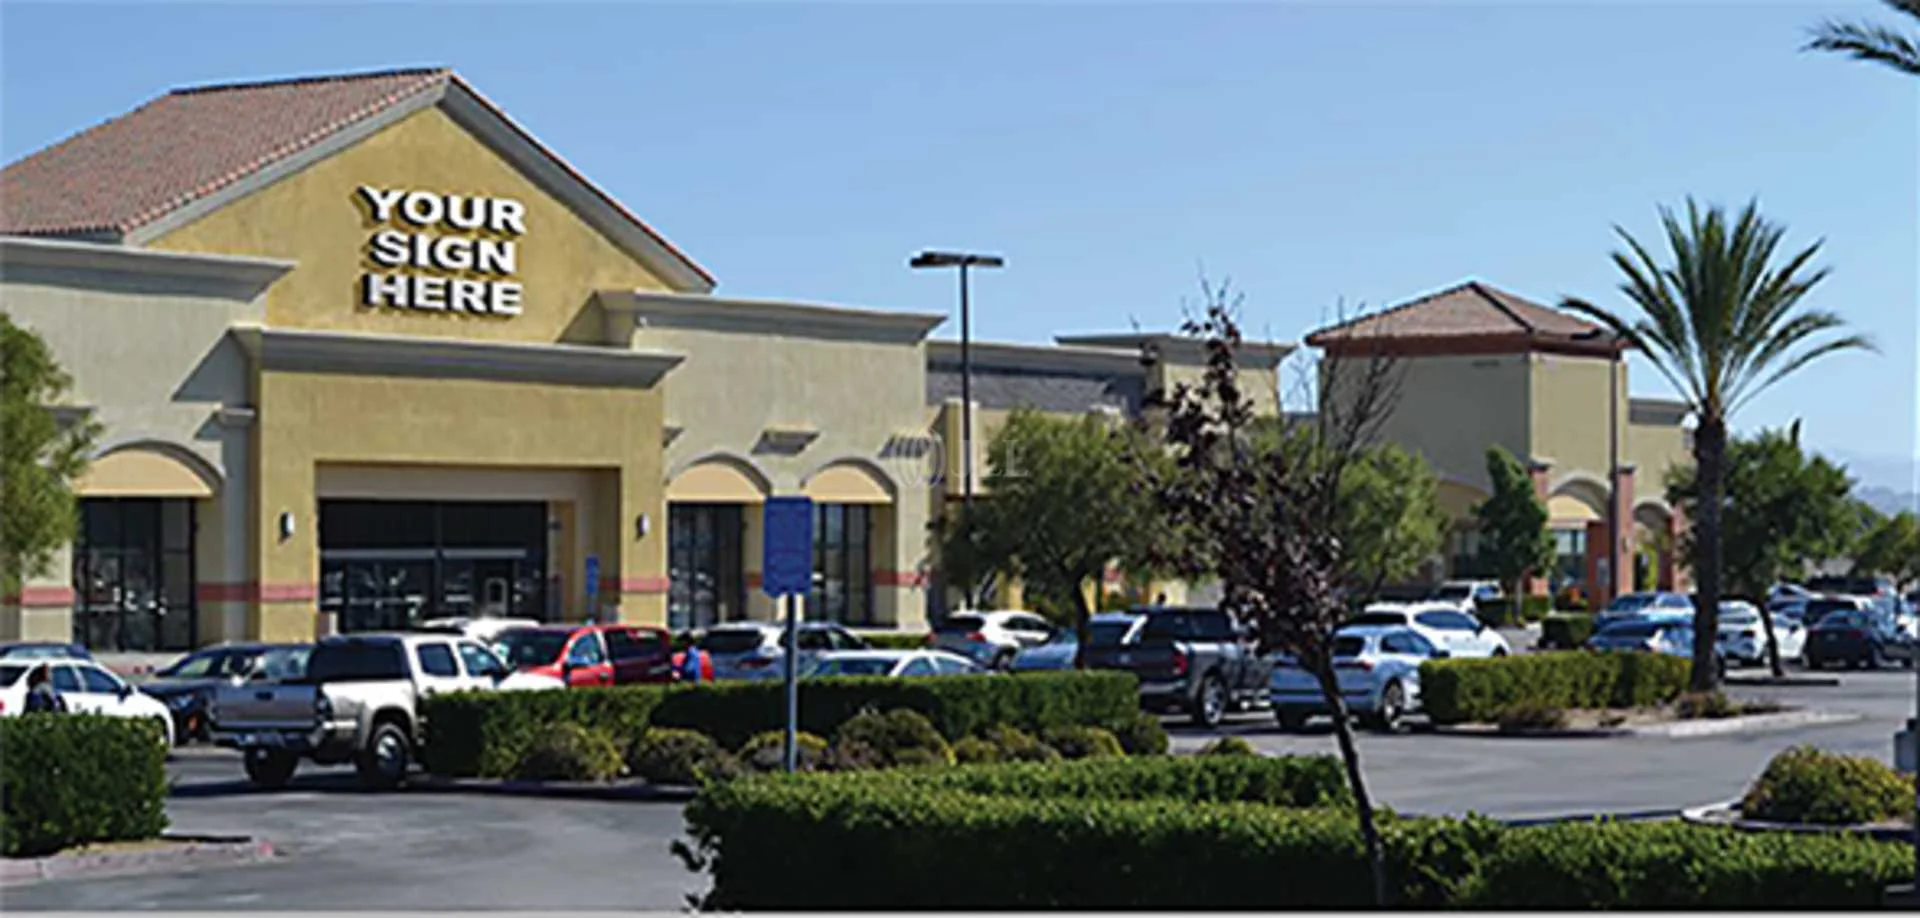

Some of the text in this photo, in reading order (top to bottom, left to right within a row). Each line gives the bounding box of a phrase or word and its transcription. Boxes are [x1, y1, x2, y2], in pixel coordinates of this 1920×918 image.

[358, 185, 527, 235] YOUR
[369, 229, 516, 275] SIGN
[363, 273, 523, 316] HERE
